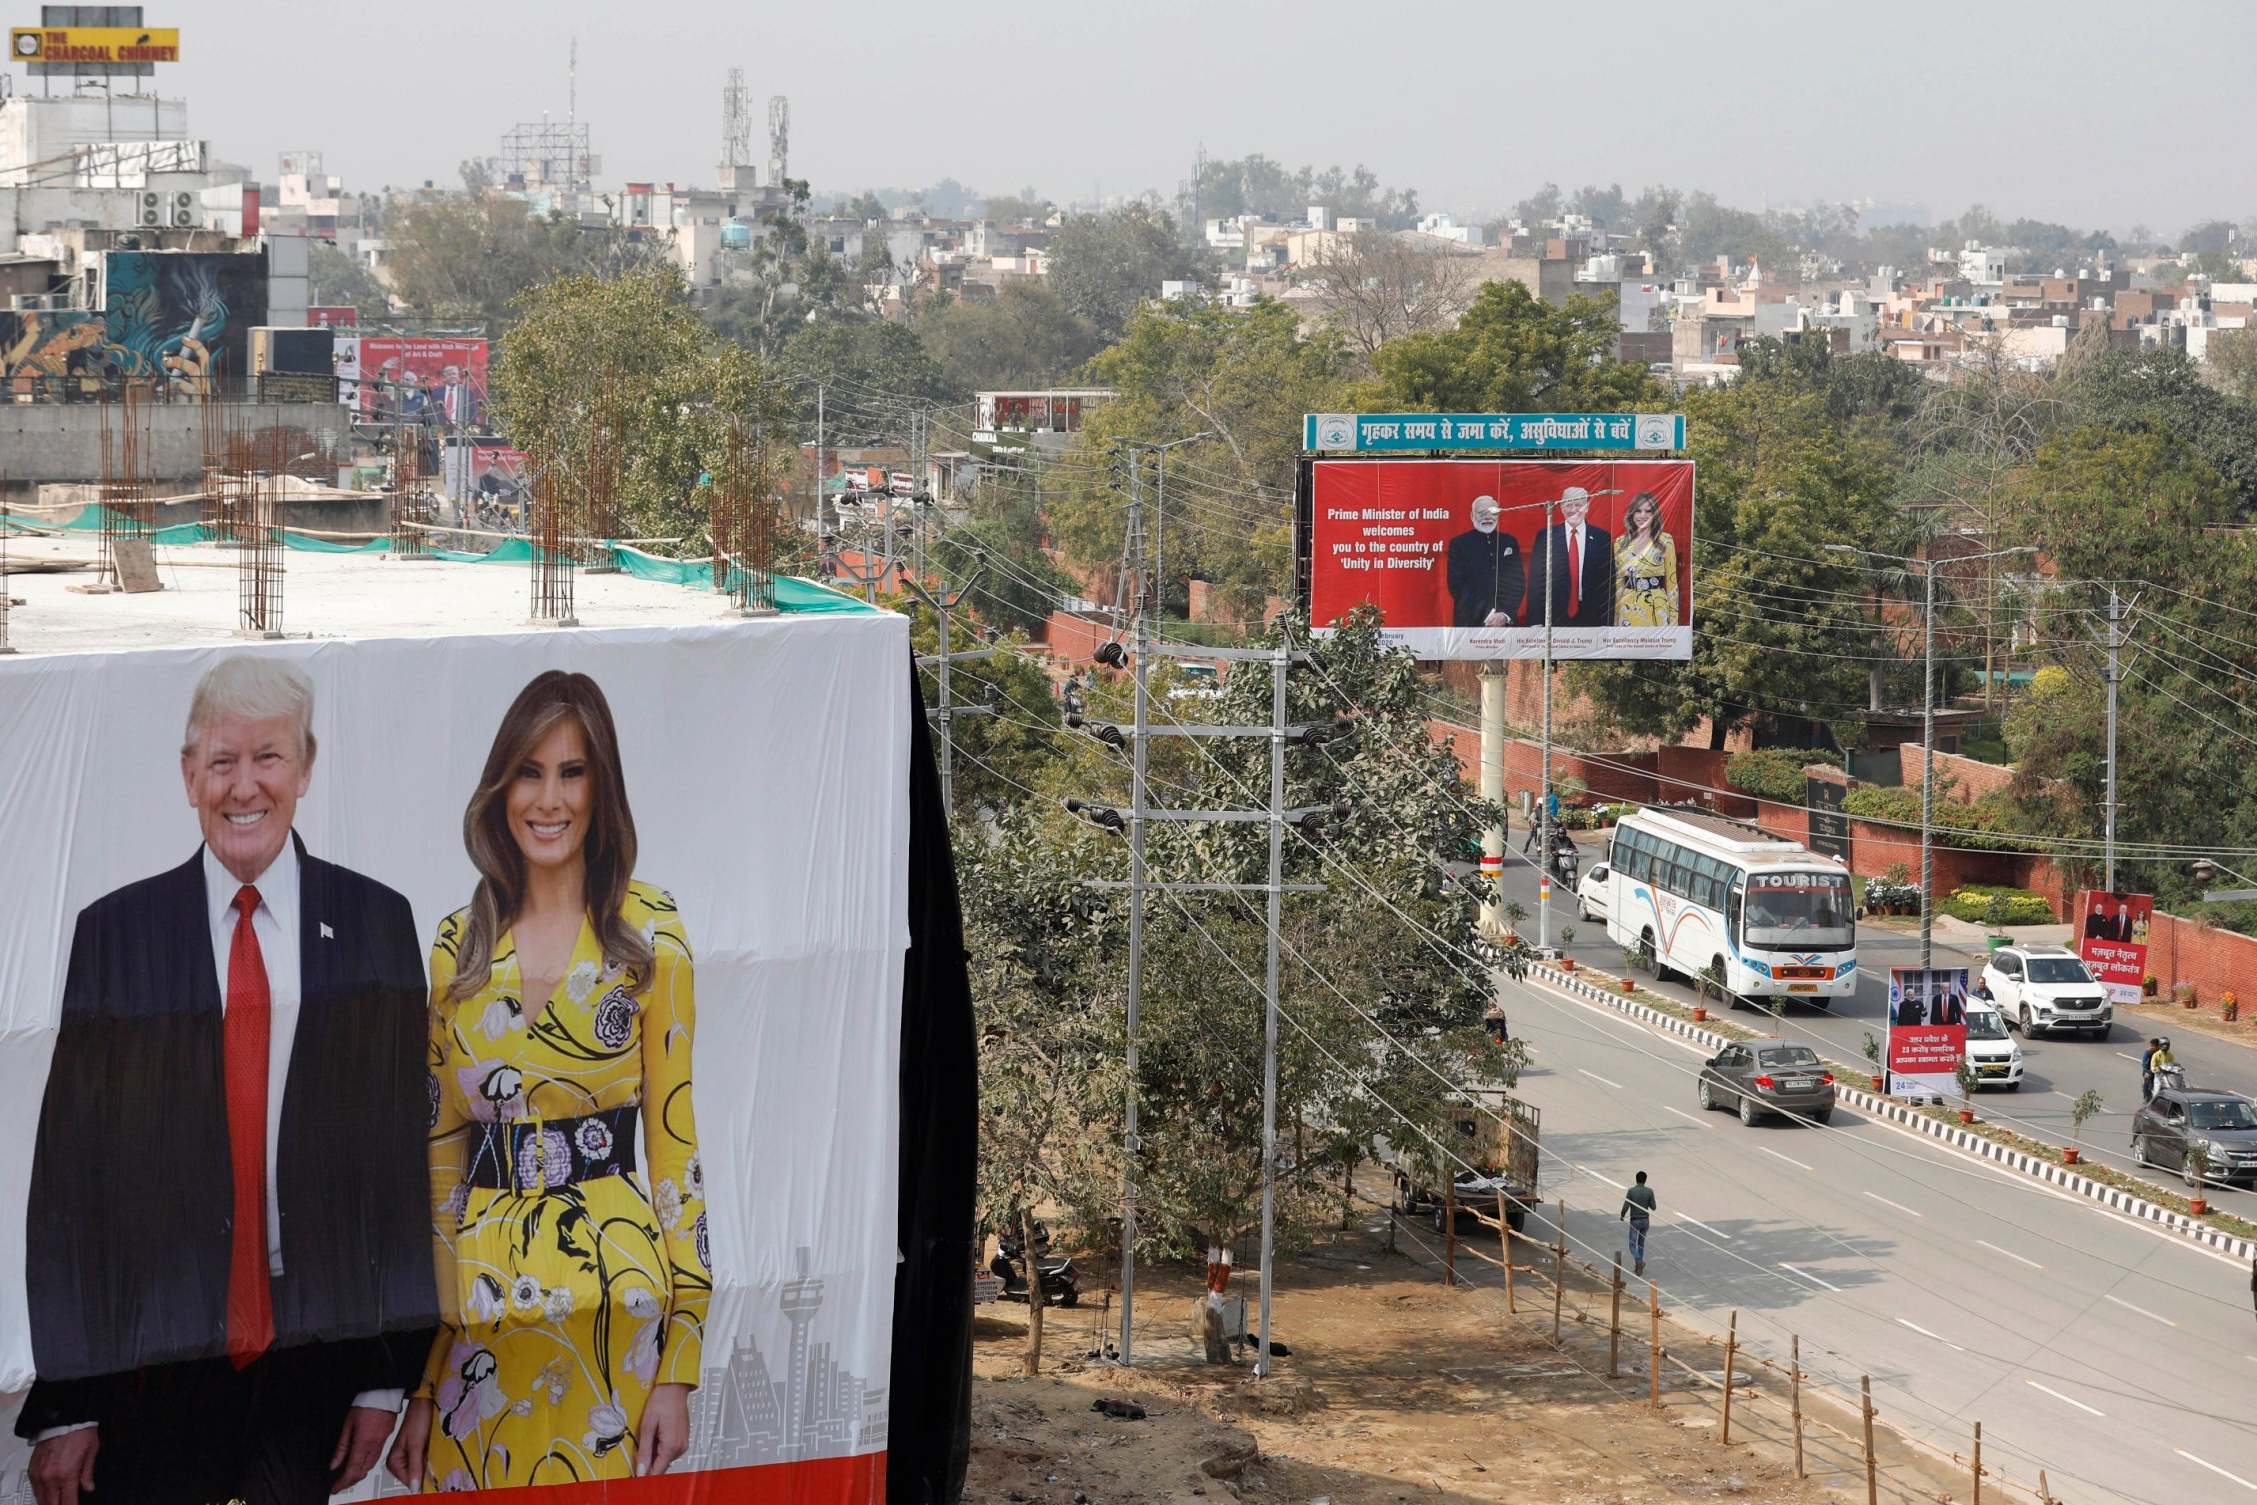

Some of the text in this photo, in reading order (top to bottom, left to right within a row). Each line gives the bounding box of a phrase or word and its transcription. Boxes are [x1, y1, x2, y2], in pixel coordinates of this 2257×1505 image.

[45, 32, 68, 44] THE
[44, 46, 178, 61] CHARCOAL CHIMNEY
[1361, 423, 1400, 445] गृहकर
[1404, 423, 1436, 439] समय
[1440, 418, 1452, 439] से
[1456, 423, 1486, 440] जमा
[1594, 418, 1606, 439] से
[1610, 418, 1632, 439] बचें
[1327, 508, 1450, 520] Prime Minister of India
[1362, 525, 1415, 536] welcomes
[1332, 540, 1444, 555] you to the country of
[1340, 557, 1435, 571] 'Unity in Diversity'
[1756, 875, 1843, 888] TOURIST
[1896, 1081, 1906, 1090] 24
